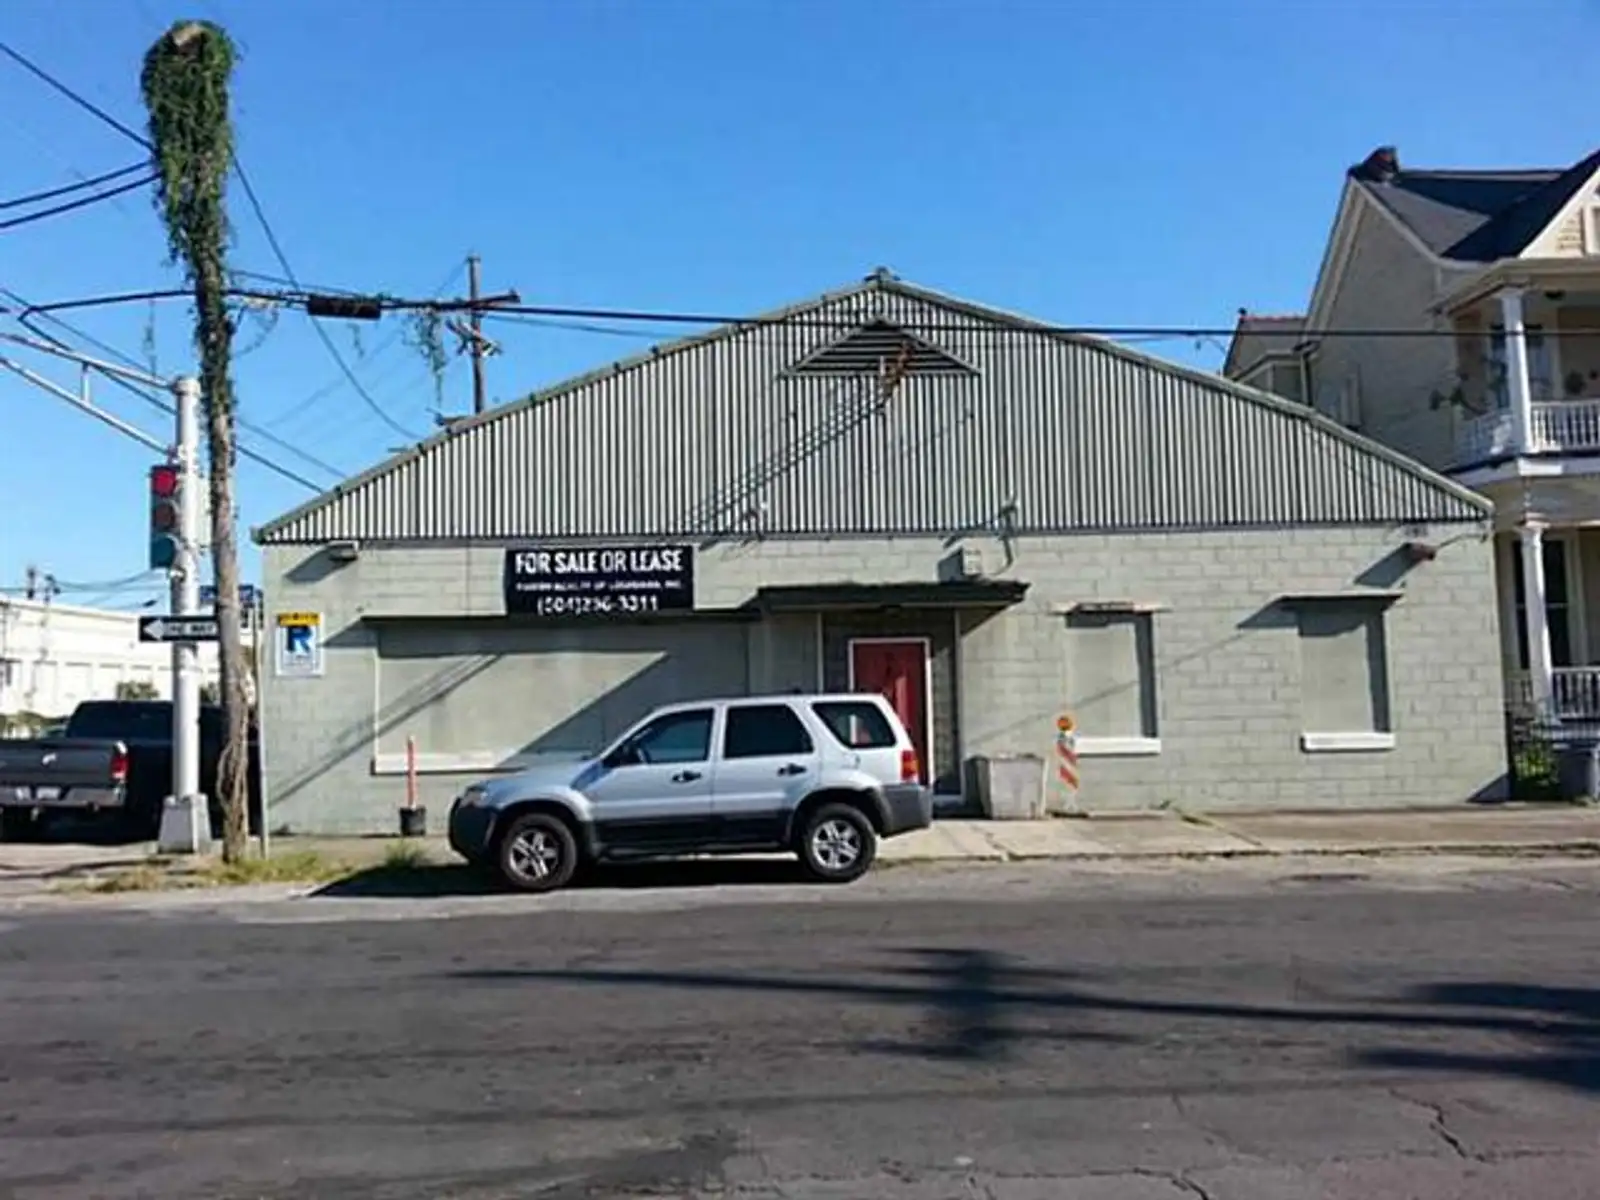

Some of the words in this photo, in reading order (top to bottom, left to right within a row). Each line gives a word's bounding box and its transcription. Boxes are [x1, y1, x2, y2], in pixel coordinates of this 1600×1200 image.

[515, 552, 551, 574] FOR
[554, 551, 598, 574] SALE
[601, 550, 627, 573] OR
[630, 549, 683, 572] LEASE
